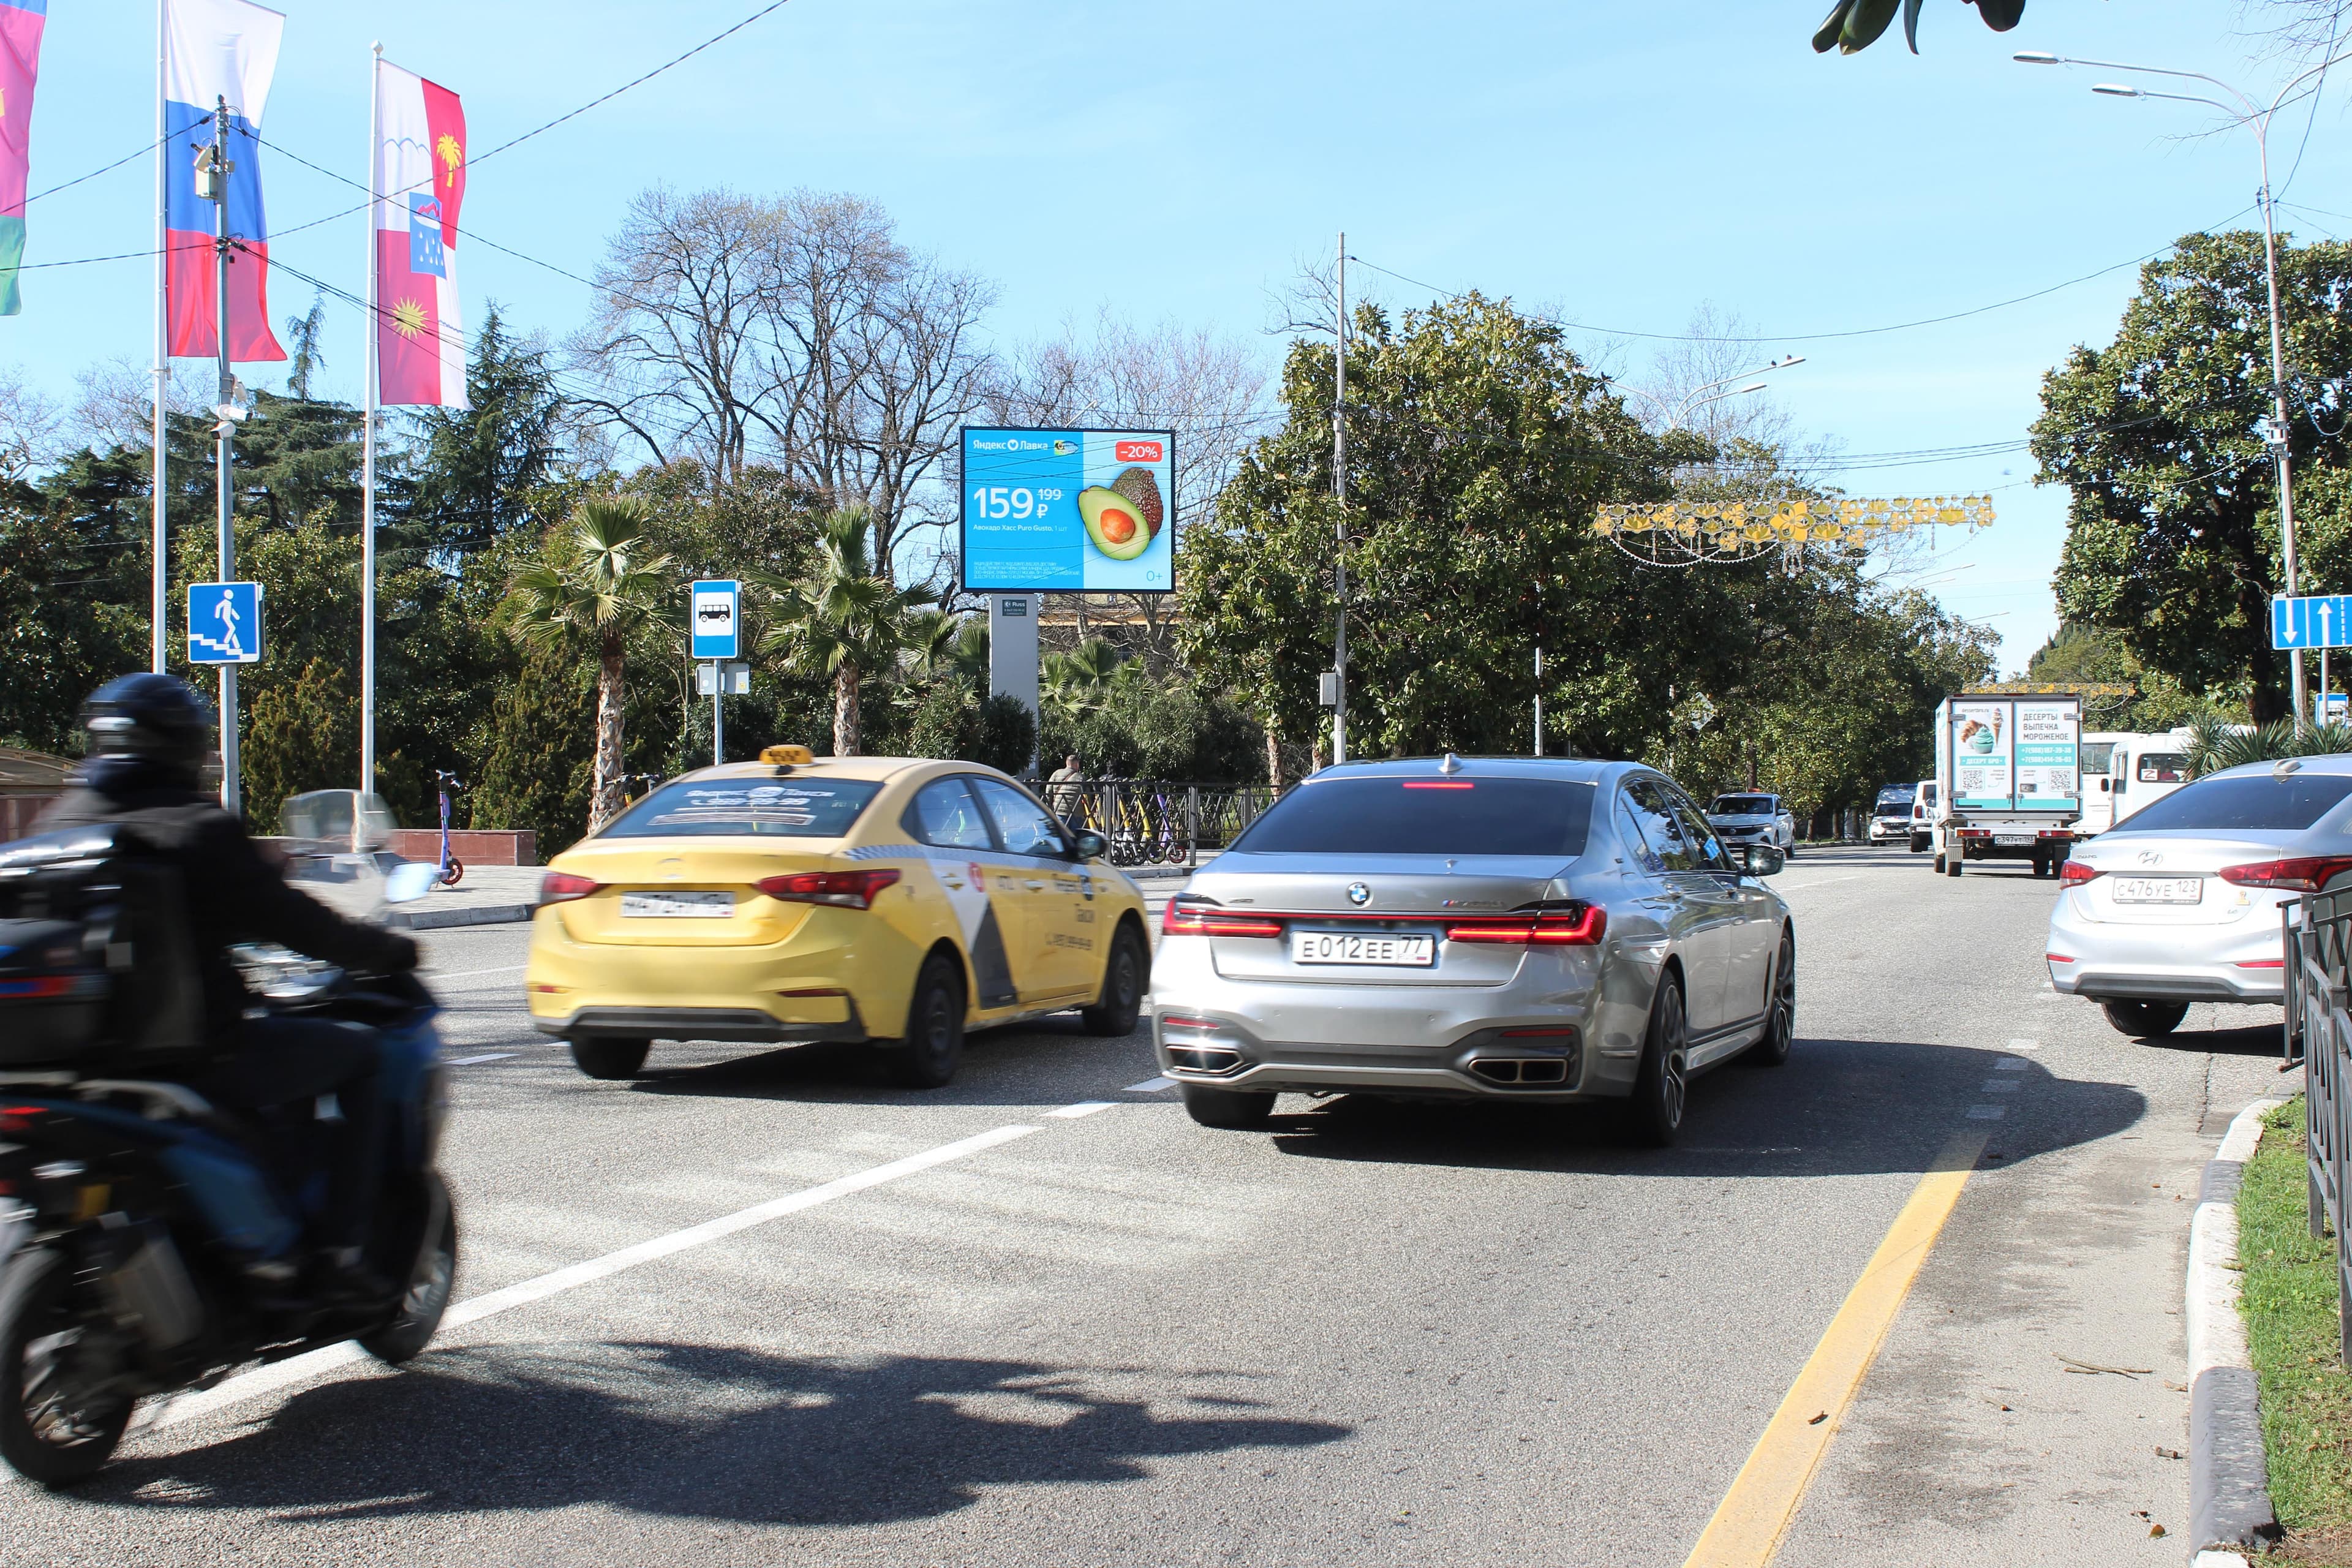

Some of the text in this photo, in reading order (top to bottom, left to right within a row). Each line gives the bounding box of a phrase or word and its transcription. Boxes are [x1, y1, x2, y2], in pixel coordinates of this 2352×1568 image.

[973, 440, 1048, 450] Яндекс Лавка
[1120, 445, 1158, 458] -20%
[1037, 489, 1063, 500] 199
[973, 488, 1033, 518] 159
[1147, 570, 1163, 581] 0+
[2176, 880, 2197, 892] 123
[1401, 936, 1423, 954] 77
